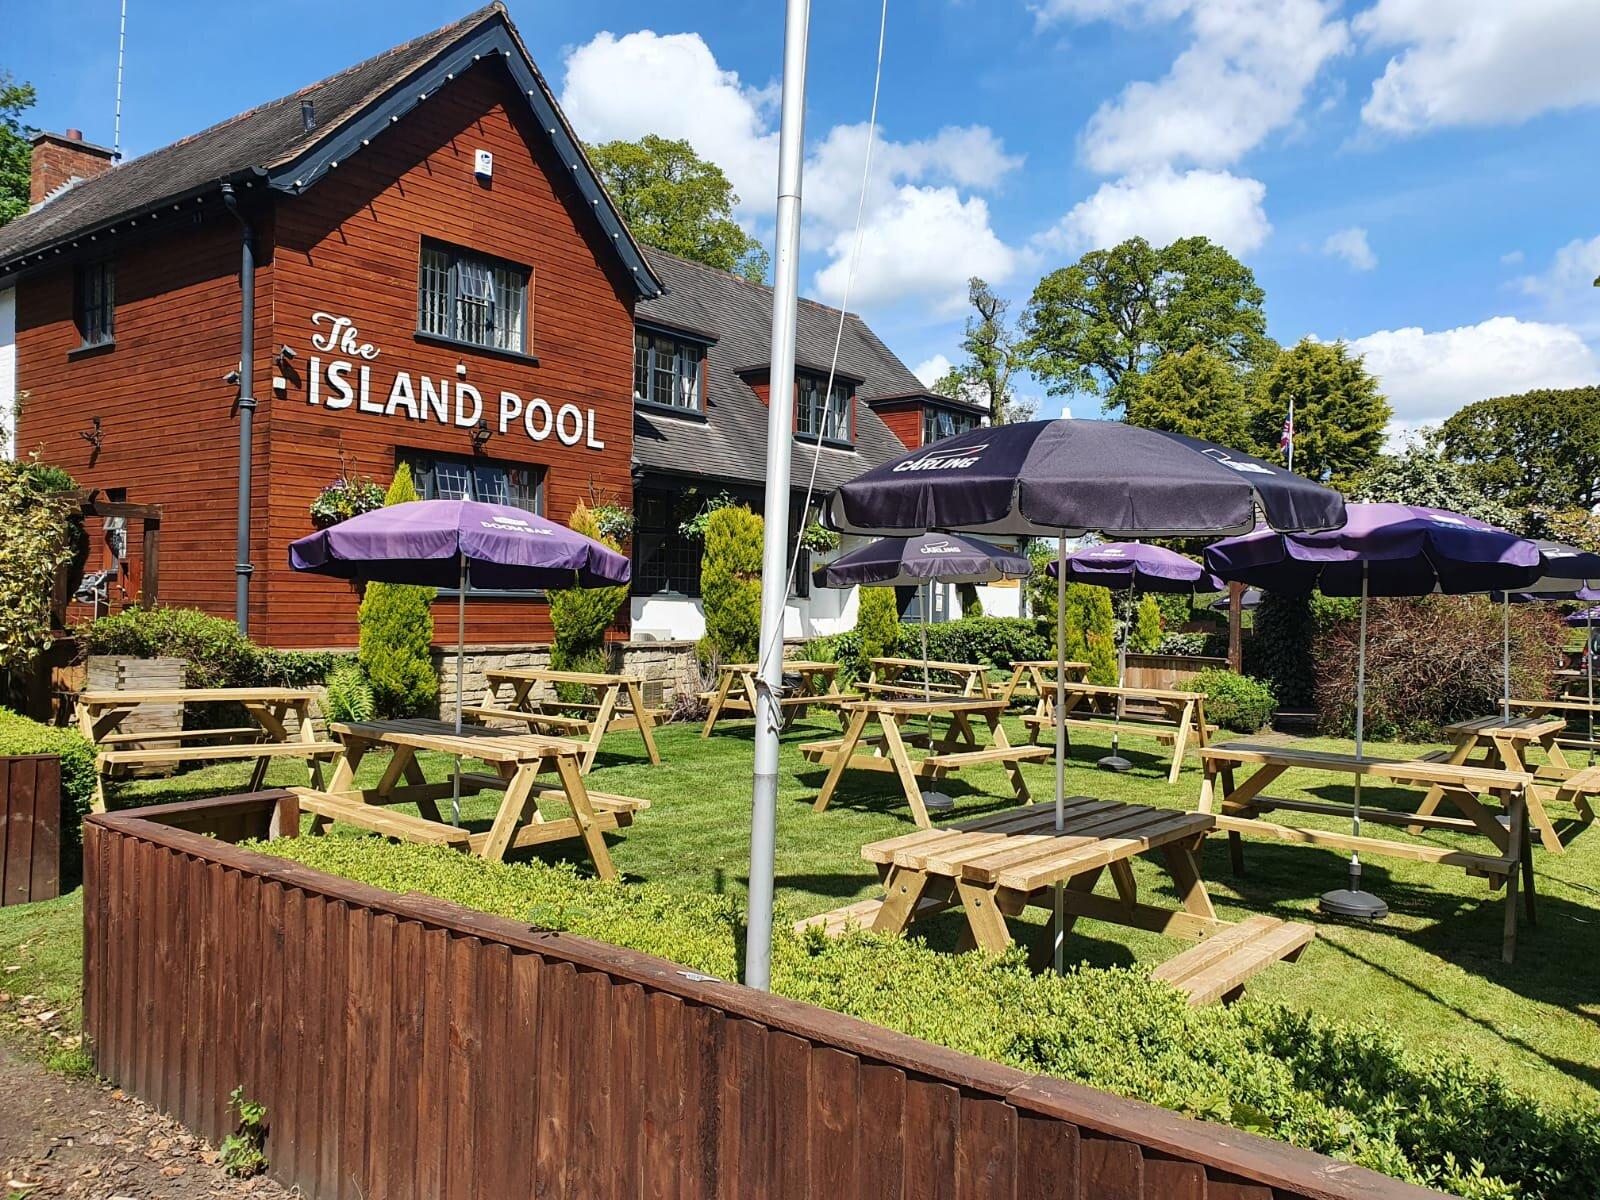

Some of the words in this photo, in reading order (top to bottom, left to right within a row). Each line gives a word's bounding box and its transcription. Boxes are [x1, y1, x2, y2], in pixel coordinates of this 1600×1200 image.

[312, 312, 381, 360] The
[308, 356, 483, 428] ISLAND
[499, 391, 605, 449] POOL
[893, 457, 981, 472] CARLING
